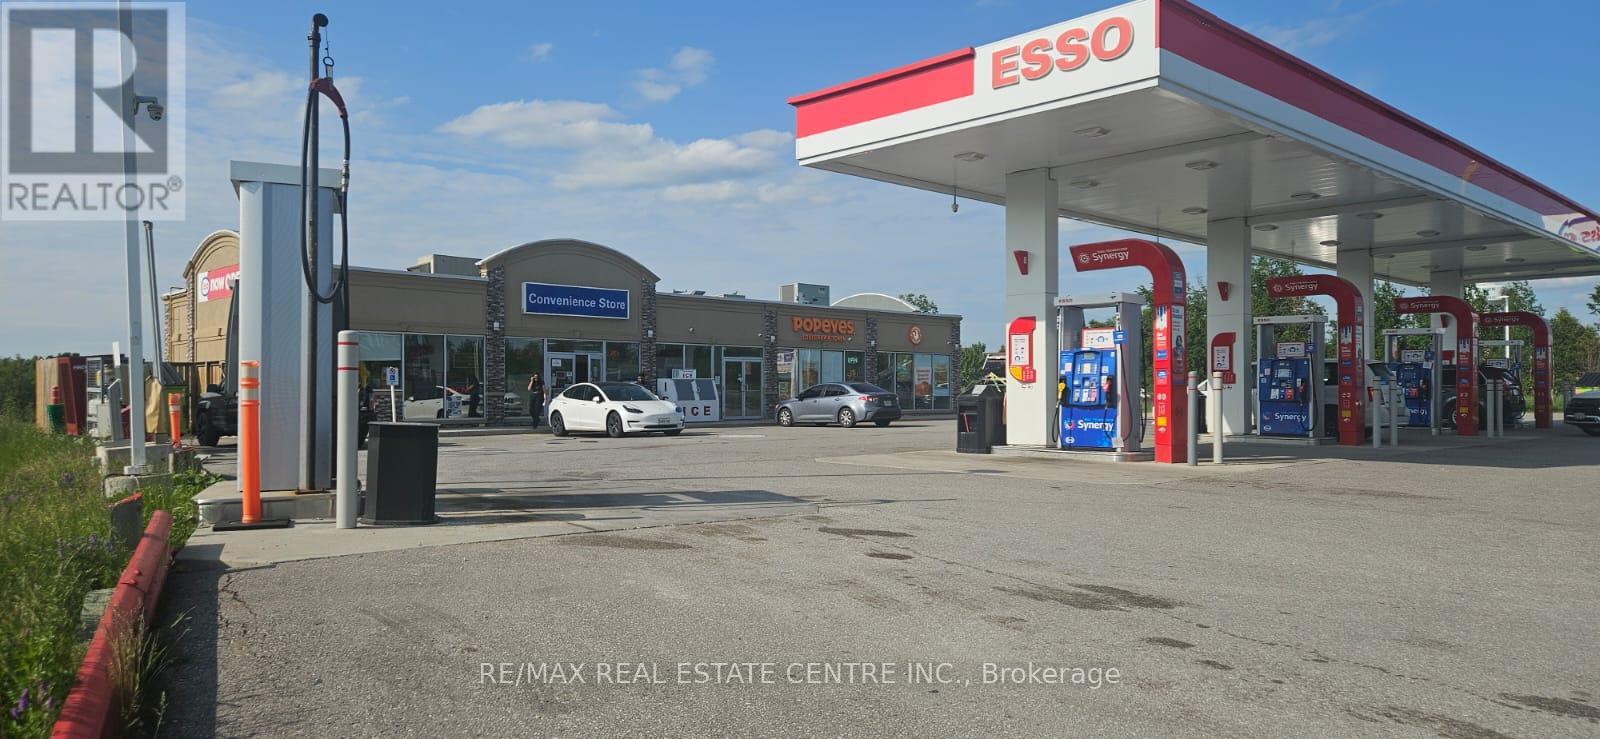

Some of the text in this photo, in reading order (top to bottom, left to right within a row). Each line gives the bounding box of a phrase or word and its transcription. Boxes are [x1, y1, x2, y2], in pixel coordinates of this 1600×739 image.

[992, 16, 1134, 90] ESSO
[1092, 251, 1129, 263] Synergy
[1285, 283, 1318, 292] Synergy
[528, 293, 626, 309] Convenience Store
[682, 405, 711, 417] ICE
[1078, 419, 1114, 432] Synergy
